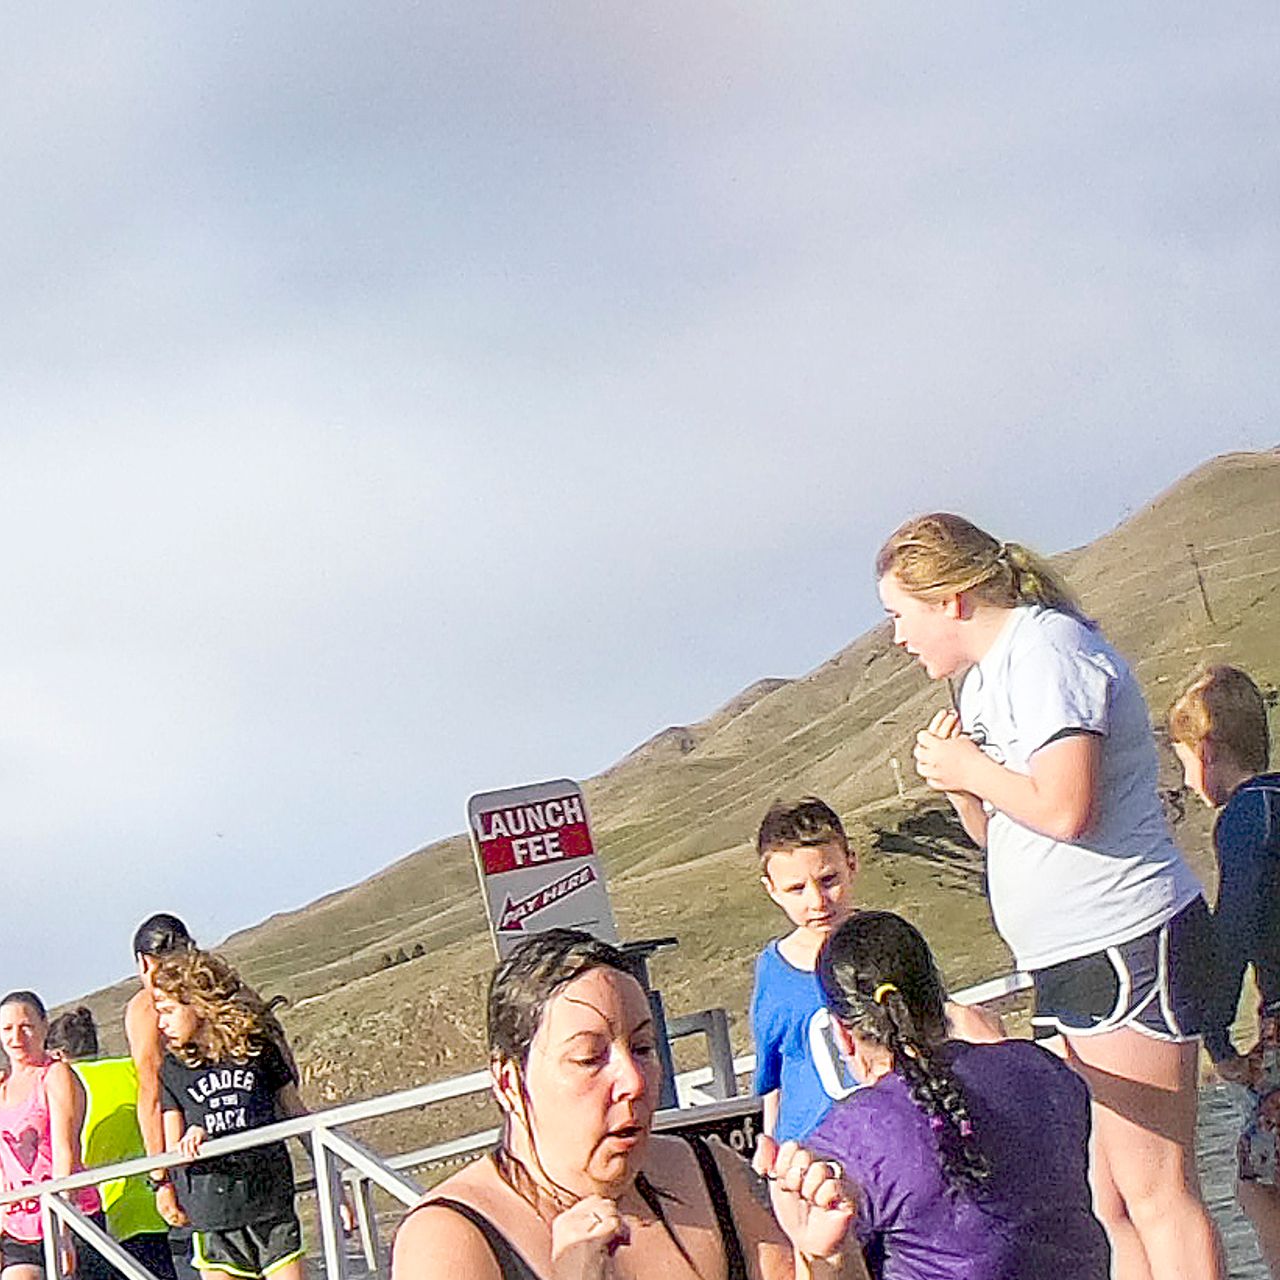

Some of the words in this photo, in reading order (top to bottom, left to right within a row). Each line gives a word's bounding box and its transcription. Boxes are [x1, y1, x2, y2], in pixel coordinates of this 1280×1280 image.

[475, 797, 584, 840] LAUNCH
[511, 832, 563, 865] FEE
[502, 896, 540, 927] PAY
[543, 868, 589, 904] HERE
[187, 1069, 254, 1103] LEADER
[205, 1107, 246, 1134] PACK
